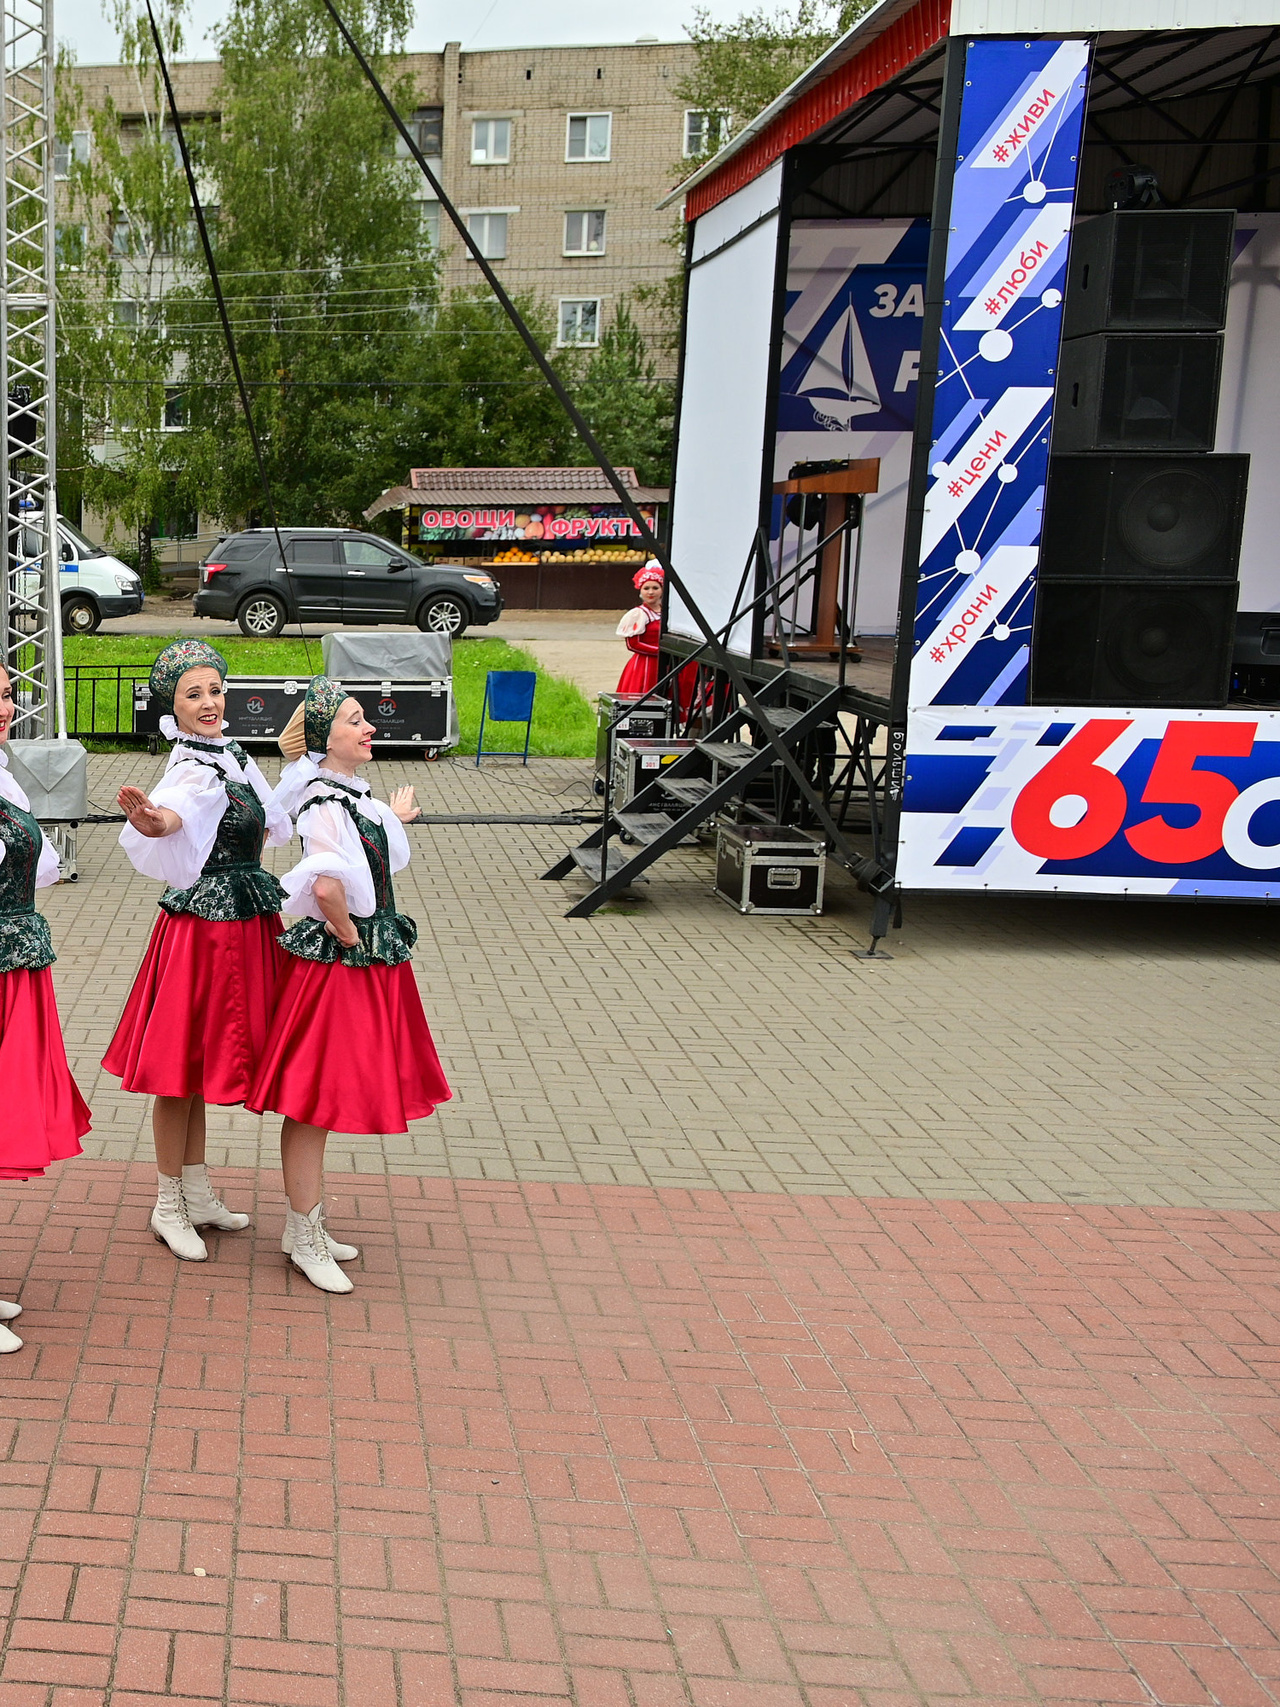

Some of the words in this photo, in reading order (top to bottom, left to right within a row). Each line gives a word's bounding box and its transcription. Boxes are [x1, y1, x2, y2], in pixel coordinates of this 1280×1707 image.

[992, 88, 1056, 163] #живи
[868, 283, 925, 318] ЗА
[984, 240, 1049, 316] #люби
[947, 429, 1008, 499] #цени
[422, 509, 516, 530] ОВОЩИ
[929, 584, 999, 664] #храни
[1011, 718, 1259, 864] 65
